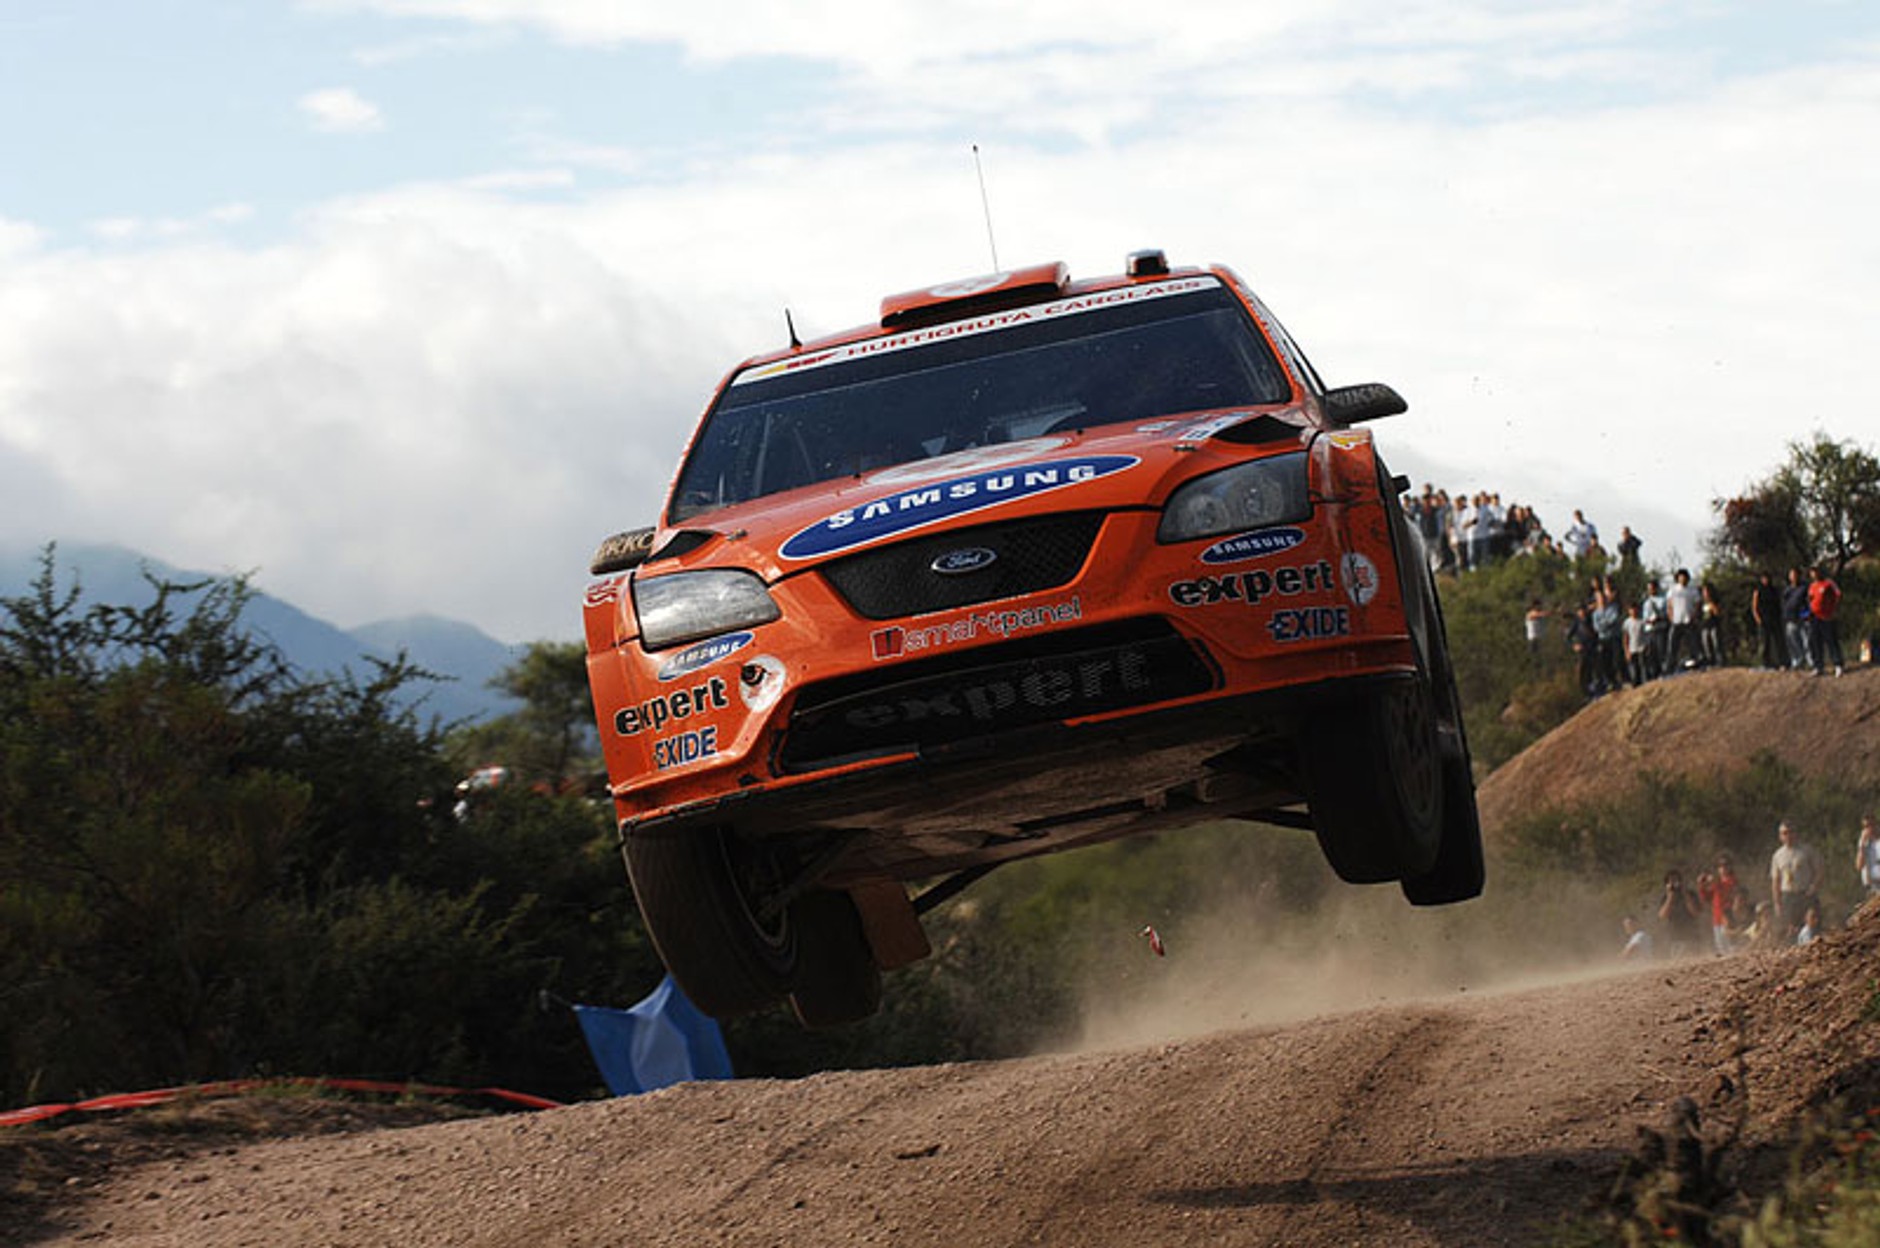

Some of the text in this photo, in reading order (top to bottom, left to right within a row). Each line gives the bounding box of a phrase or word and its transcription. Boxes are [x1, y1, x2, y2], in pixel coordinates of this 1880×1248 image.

[847, 281, 1201, 356] HURTIGRUTA CARGLASS
[826, 464, 1097, 530] SAMSUNG
[946, 552, 982, 568] Ford
[1211, 534, 1298, 556] SAMSUNG
[1169, 559, 1334, 606] expert
[904, 594, 1082, 651] smartpanel
[1267, 608, 1349, 641] EXIDE
[667, 639, 742, 671] SAMSUNG
[614, 674, 730, 736] expert
[846, 650, 1150, 728] expert
[652, 724, 718, 771] EXIDE
